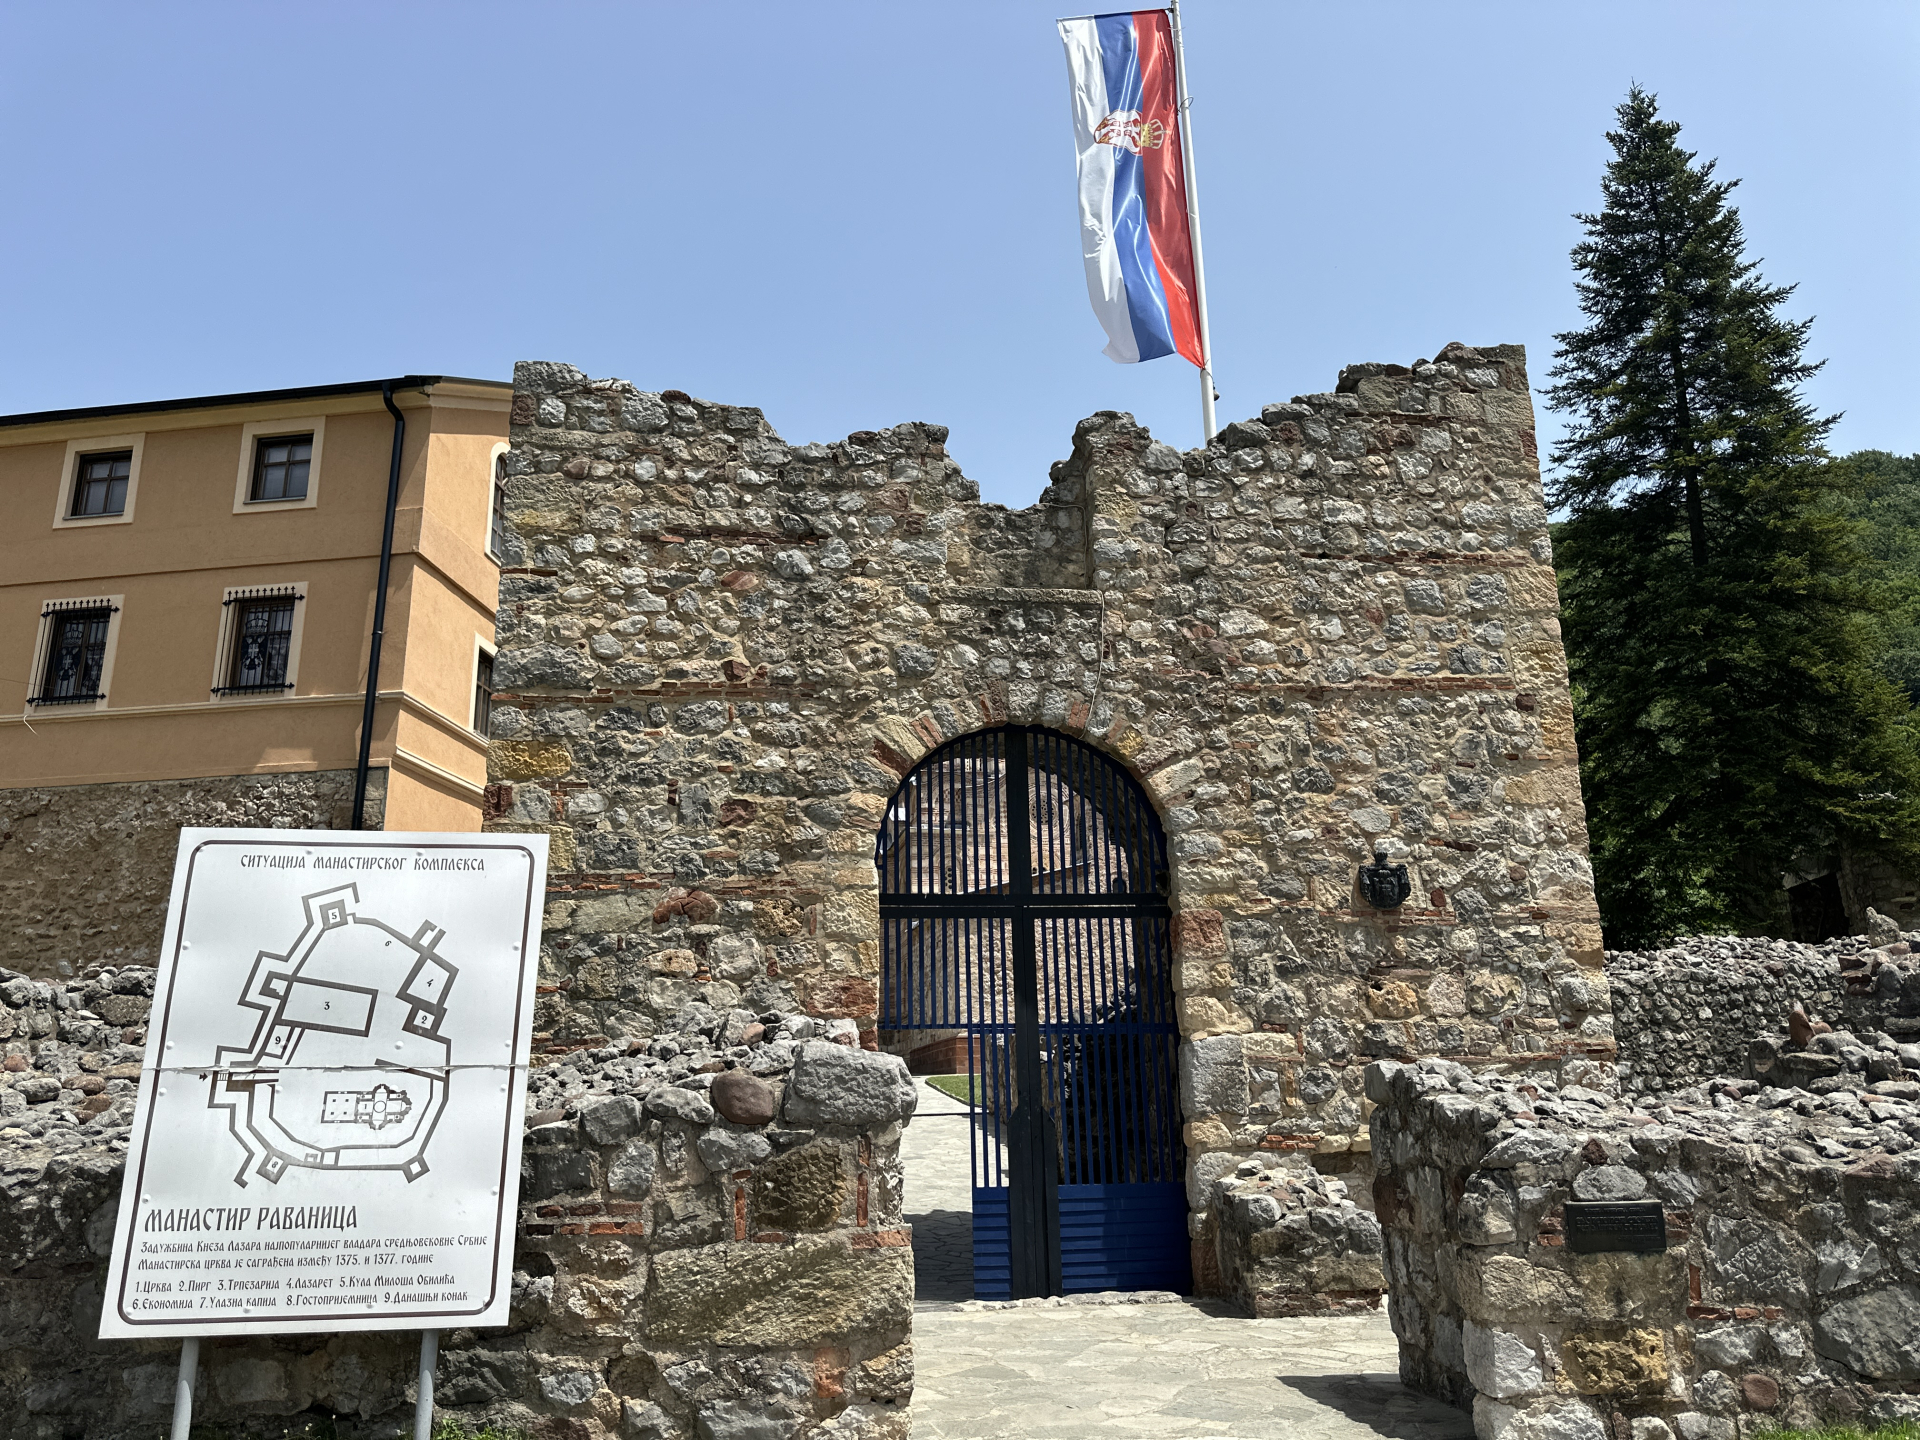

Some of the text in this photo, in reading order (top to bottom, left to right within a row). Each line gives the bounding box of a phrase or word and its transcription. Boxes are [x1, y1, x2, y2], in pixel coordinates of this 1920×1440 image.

[240, 854, 485, 871] СИТУАЦИЈА МАНАСТИРСКОГ КОМПЛЕКСА
[331, 912, 338, 920] 5
[426, 978, 434, 988] 4
[324, 1001, 331, 1011] 3
[421, 1015, 428, 1024] 2
[275, 1036, 281, 1045] 9
[271, 1161, 278, 1169] 8
[144, 1205, 359, 1233] МАНАСТИР РАВАНИЦА
[336, 1254, 361, 1266] 1375.
[373, 1253, 398, 1265] 1377.
